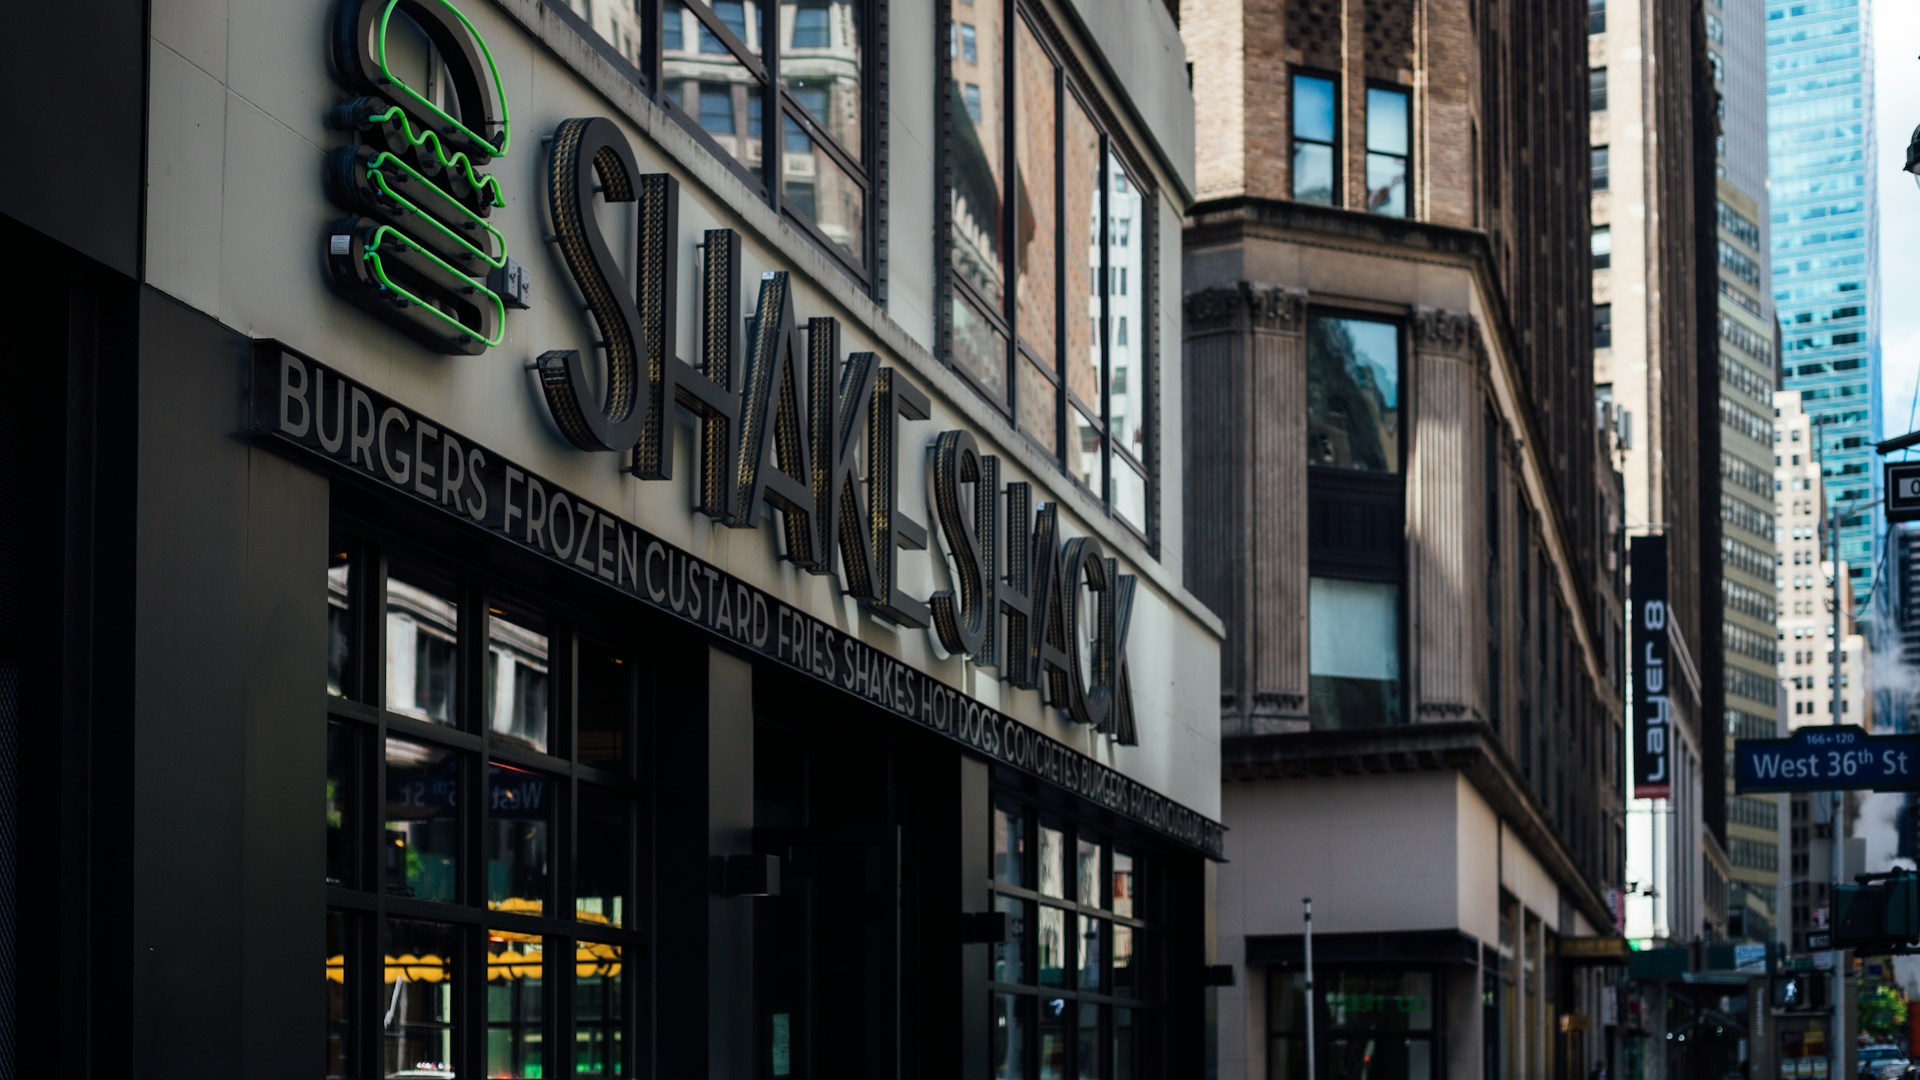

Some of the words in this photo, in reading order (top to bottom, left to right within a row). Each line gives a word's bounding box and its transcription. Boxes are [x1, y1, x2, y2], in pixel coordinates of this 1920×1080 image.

[537, 117, 930, 628] SHAKE
[930, 430, 1138, 746] SHACK
[279, 350, 487, 521] BURGERS
[504, 465, 638, 592] FROZEN
[645, 541, 768, 648] CUSTARD
[778, 605, 836, 681] FRIES
[843, 638, 915, 717] SHAKES
[921, 677, 956, 734] HOT
[958, 696, 1000, 755] DOGS
[1003, 720, 1079, 791] CONCRETES
[1081, 758, 1129, 813] BURGERS
[1643, 599, 1665, 631] 8
[1806, 733, 1825, 746] 166
[1836, 733, 1854, 744] 120
[1752, 753, 1820, 779] West
[1827, 747, 1874, 777] 36th
[1882, 749, 1909, 776] St
